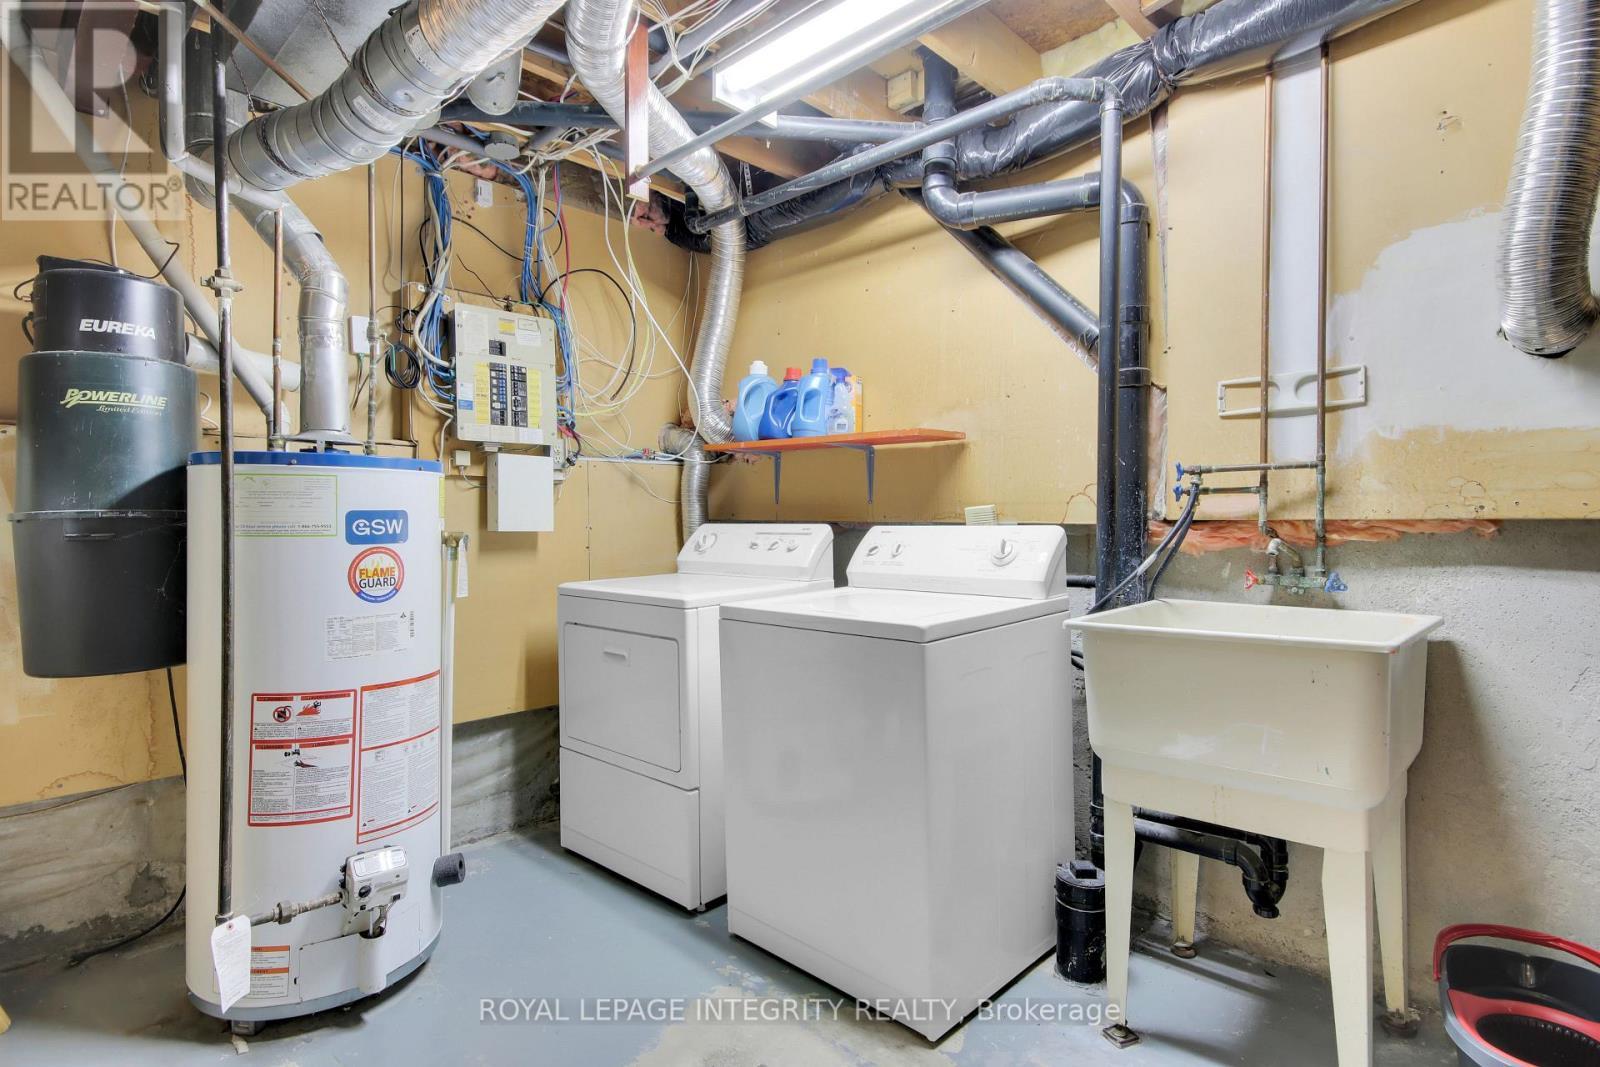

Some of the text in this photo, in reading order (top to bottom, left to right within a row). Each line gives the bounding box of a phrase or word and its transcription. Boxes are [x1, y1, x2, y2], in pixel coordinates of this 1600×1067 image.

[79, 318, 156, 341] EUREKA
[60, 388, 168, 409] POWERLINE
[352, 518, 403, 536] GSW
[359, 567, 396, 579] FLAME
[359, 577, 396, 589] GUARD
